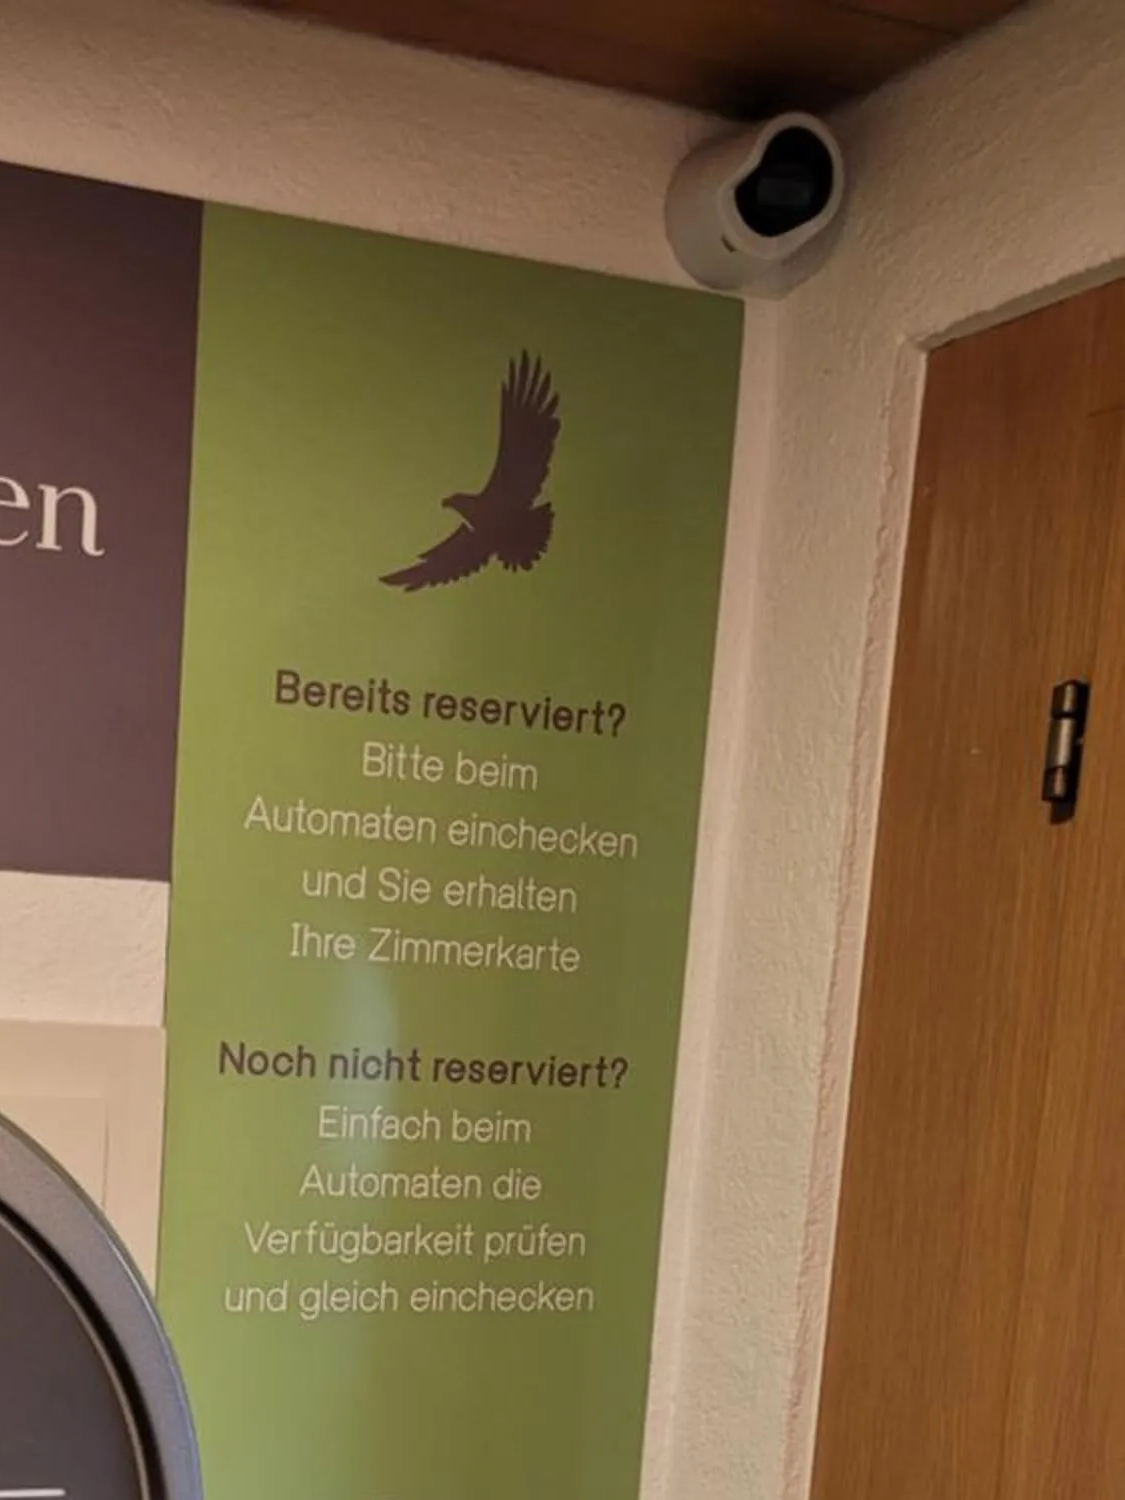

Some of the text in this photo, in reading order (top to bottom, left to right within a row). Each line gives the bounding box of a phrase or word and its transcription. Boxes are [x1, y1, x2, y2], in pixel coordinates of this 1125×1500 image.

[275, 669, 626, 737] Bereits reserviert?
[362, 741, 538, 791] Bitte beim
[244, 795, 638, 858] Automaten einchecken
[302, 866, 577, 912] und Sie erhalten
[289, 922, 580, 972] Ihre Zimmerkarte
[218, 1041, 629, 1089] Noch nicht reserviert?
[319, 1105, 531, 1143] Einfach beim
[299, 1163, 542, 1200] Automaten die
[244, 1221, 586, 1263] Verfügbarkeit prüfen
[225, 1280, 594, 1320] und gleich einchecken
